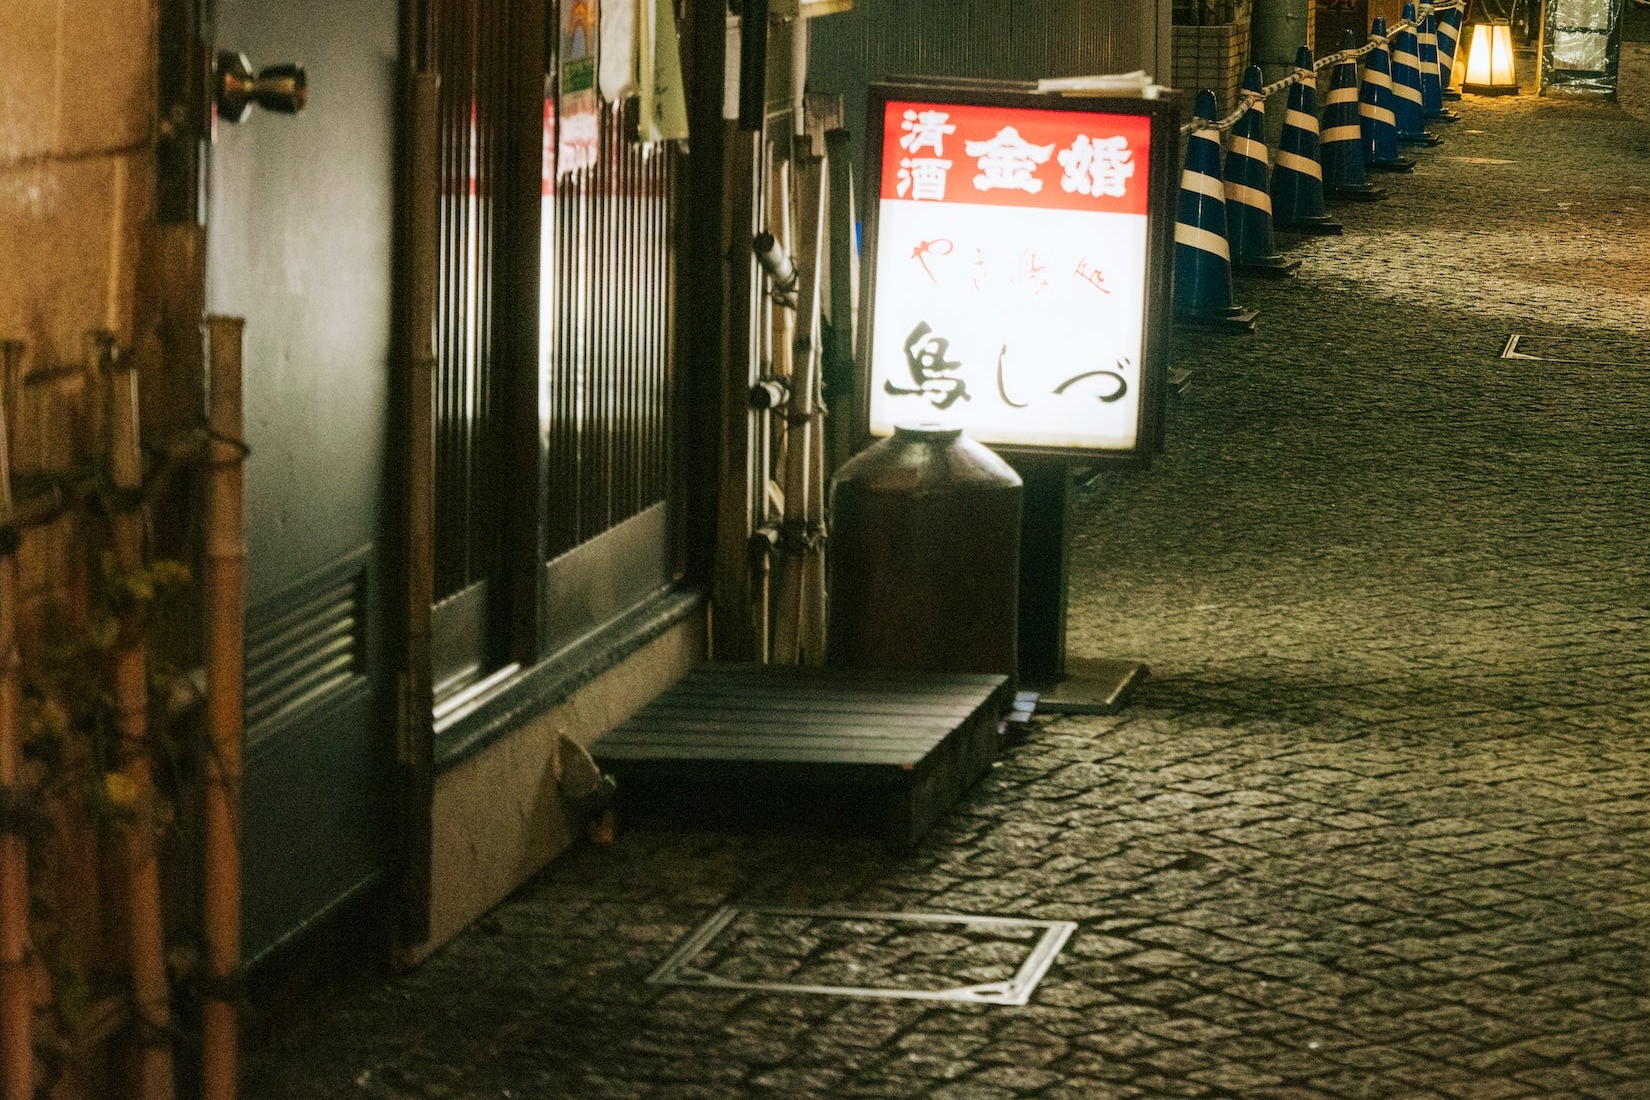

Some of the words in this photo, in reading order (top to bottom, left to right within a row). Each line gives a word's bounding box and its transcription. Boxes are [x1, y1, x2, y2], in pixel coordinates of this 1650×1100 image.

[896, 110, 956, 201] 清酒
[965, 126, 1134, 198] 金婚
[883, 320, 1132, 411] 鳥しづ
